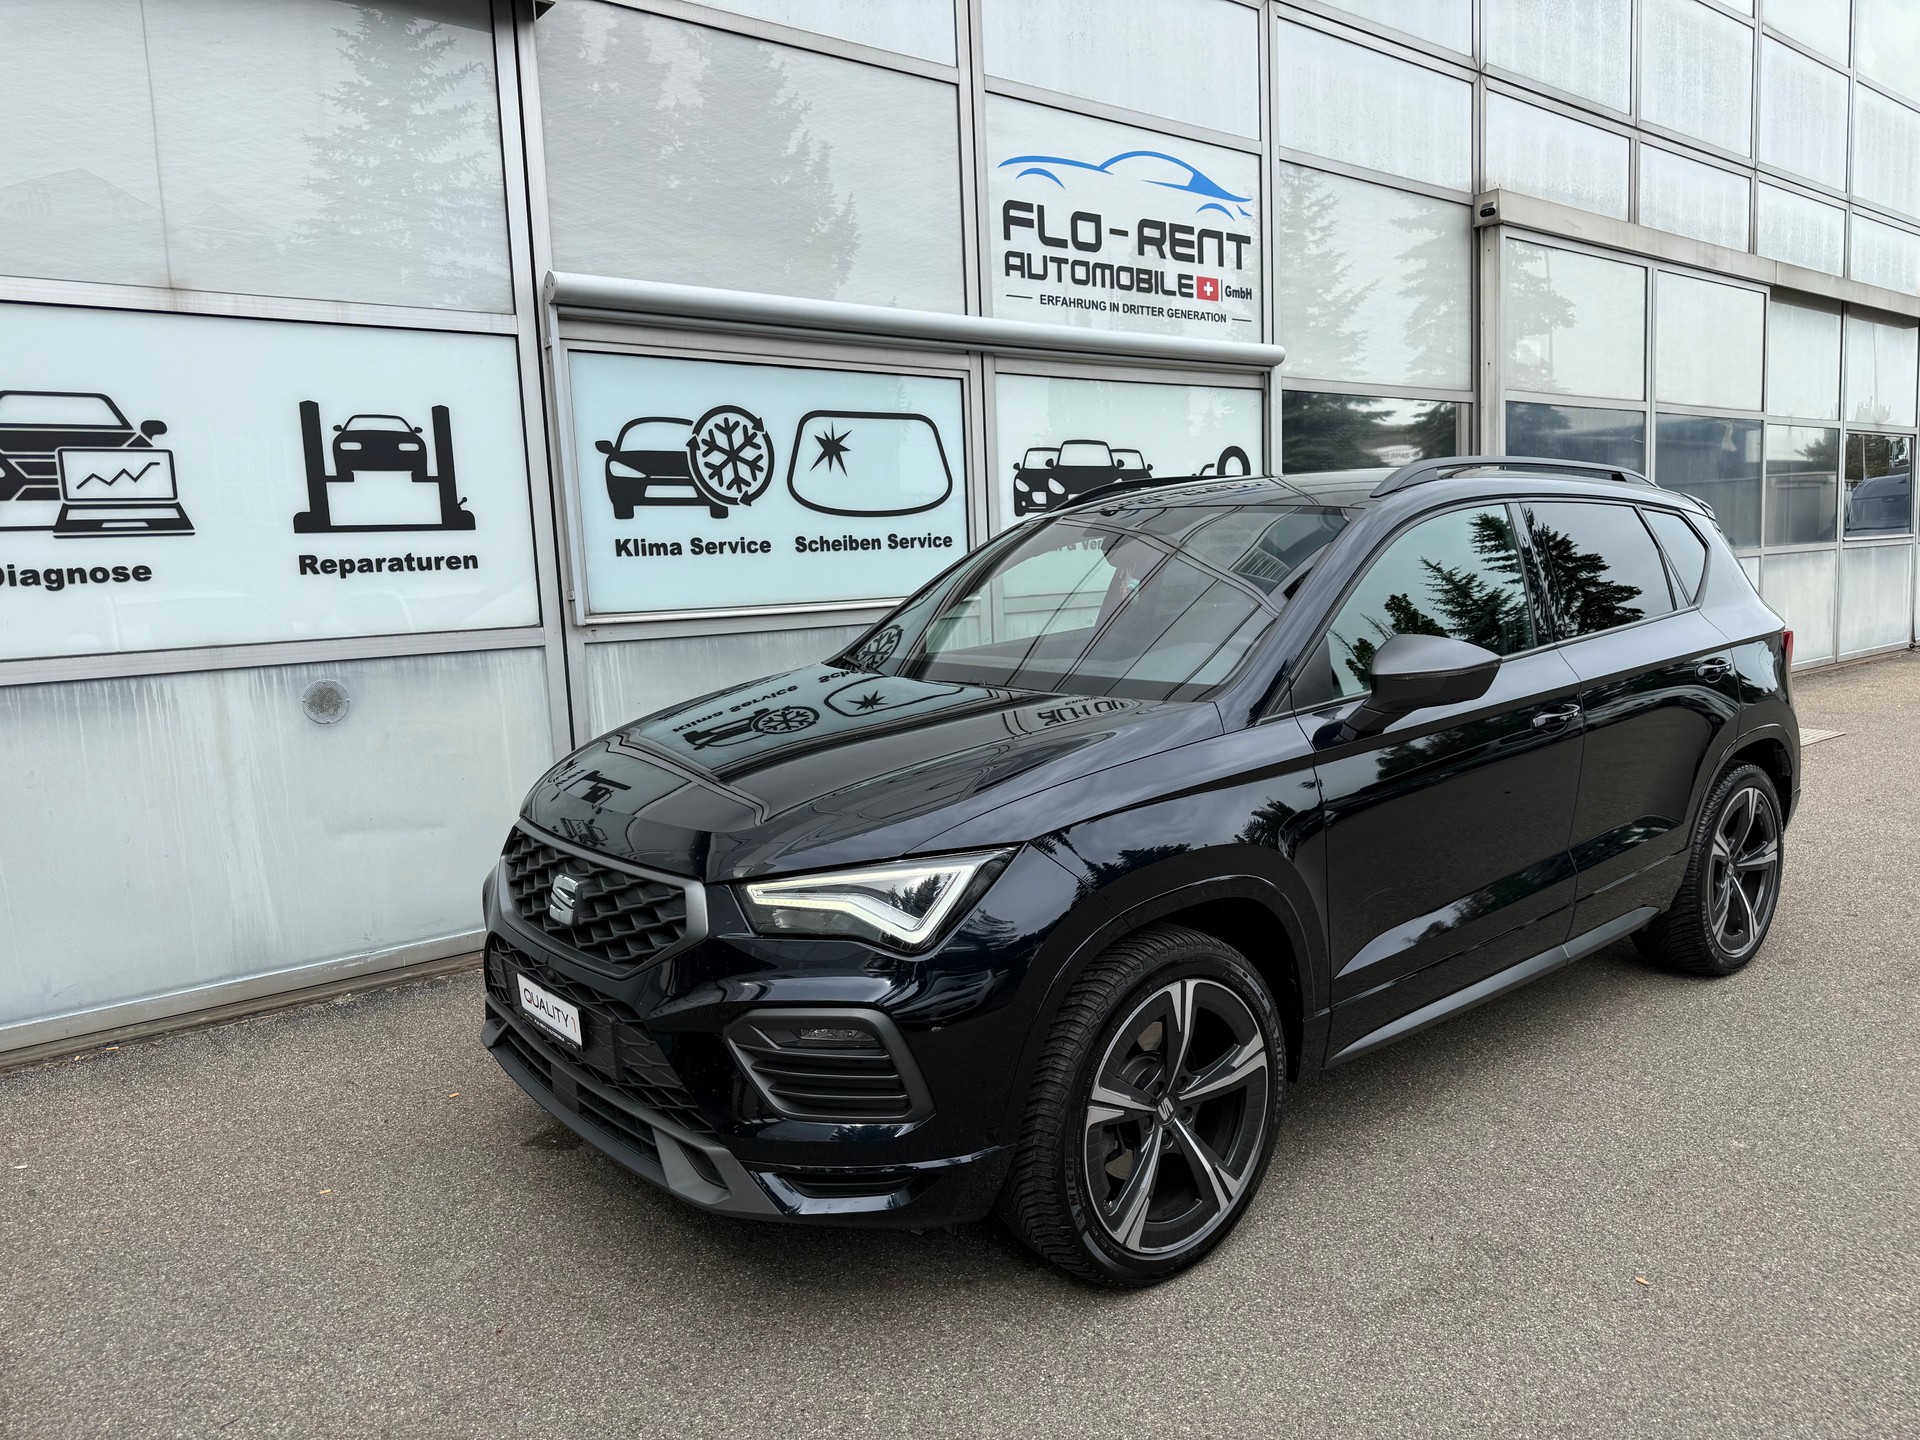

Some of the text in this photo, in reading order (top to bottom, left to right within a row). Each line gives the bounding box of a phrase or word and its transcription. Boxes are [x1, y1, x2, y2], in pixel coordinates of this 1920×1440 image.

[1002, 199, 1251, 270] FLO-RENT
[1004, 250, 1253, 301] AUTOMOBILE GmbH
[1039, 294, 1227, 323] ERFAHRUNG IN DRITTER GENERATION
[615, 536, 772, 557] Klima Service
[794, 533, 953, 553] Scheiben Service
[0, 554, 479, 591] iagnose Reparaturen
